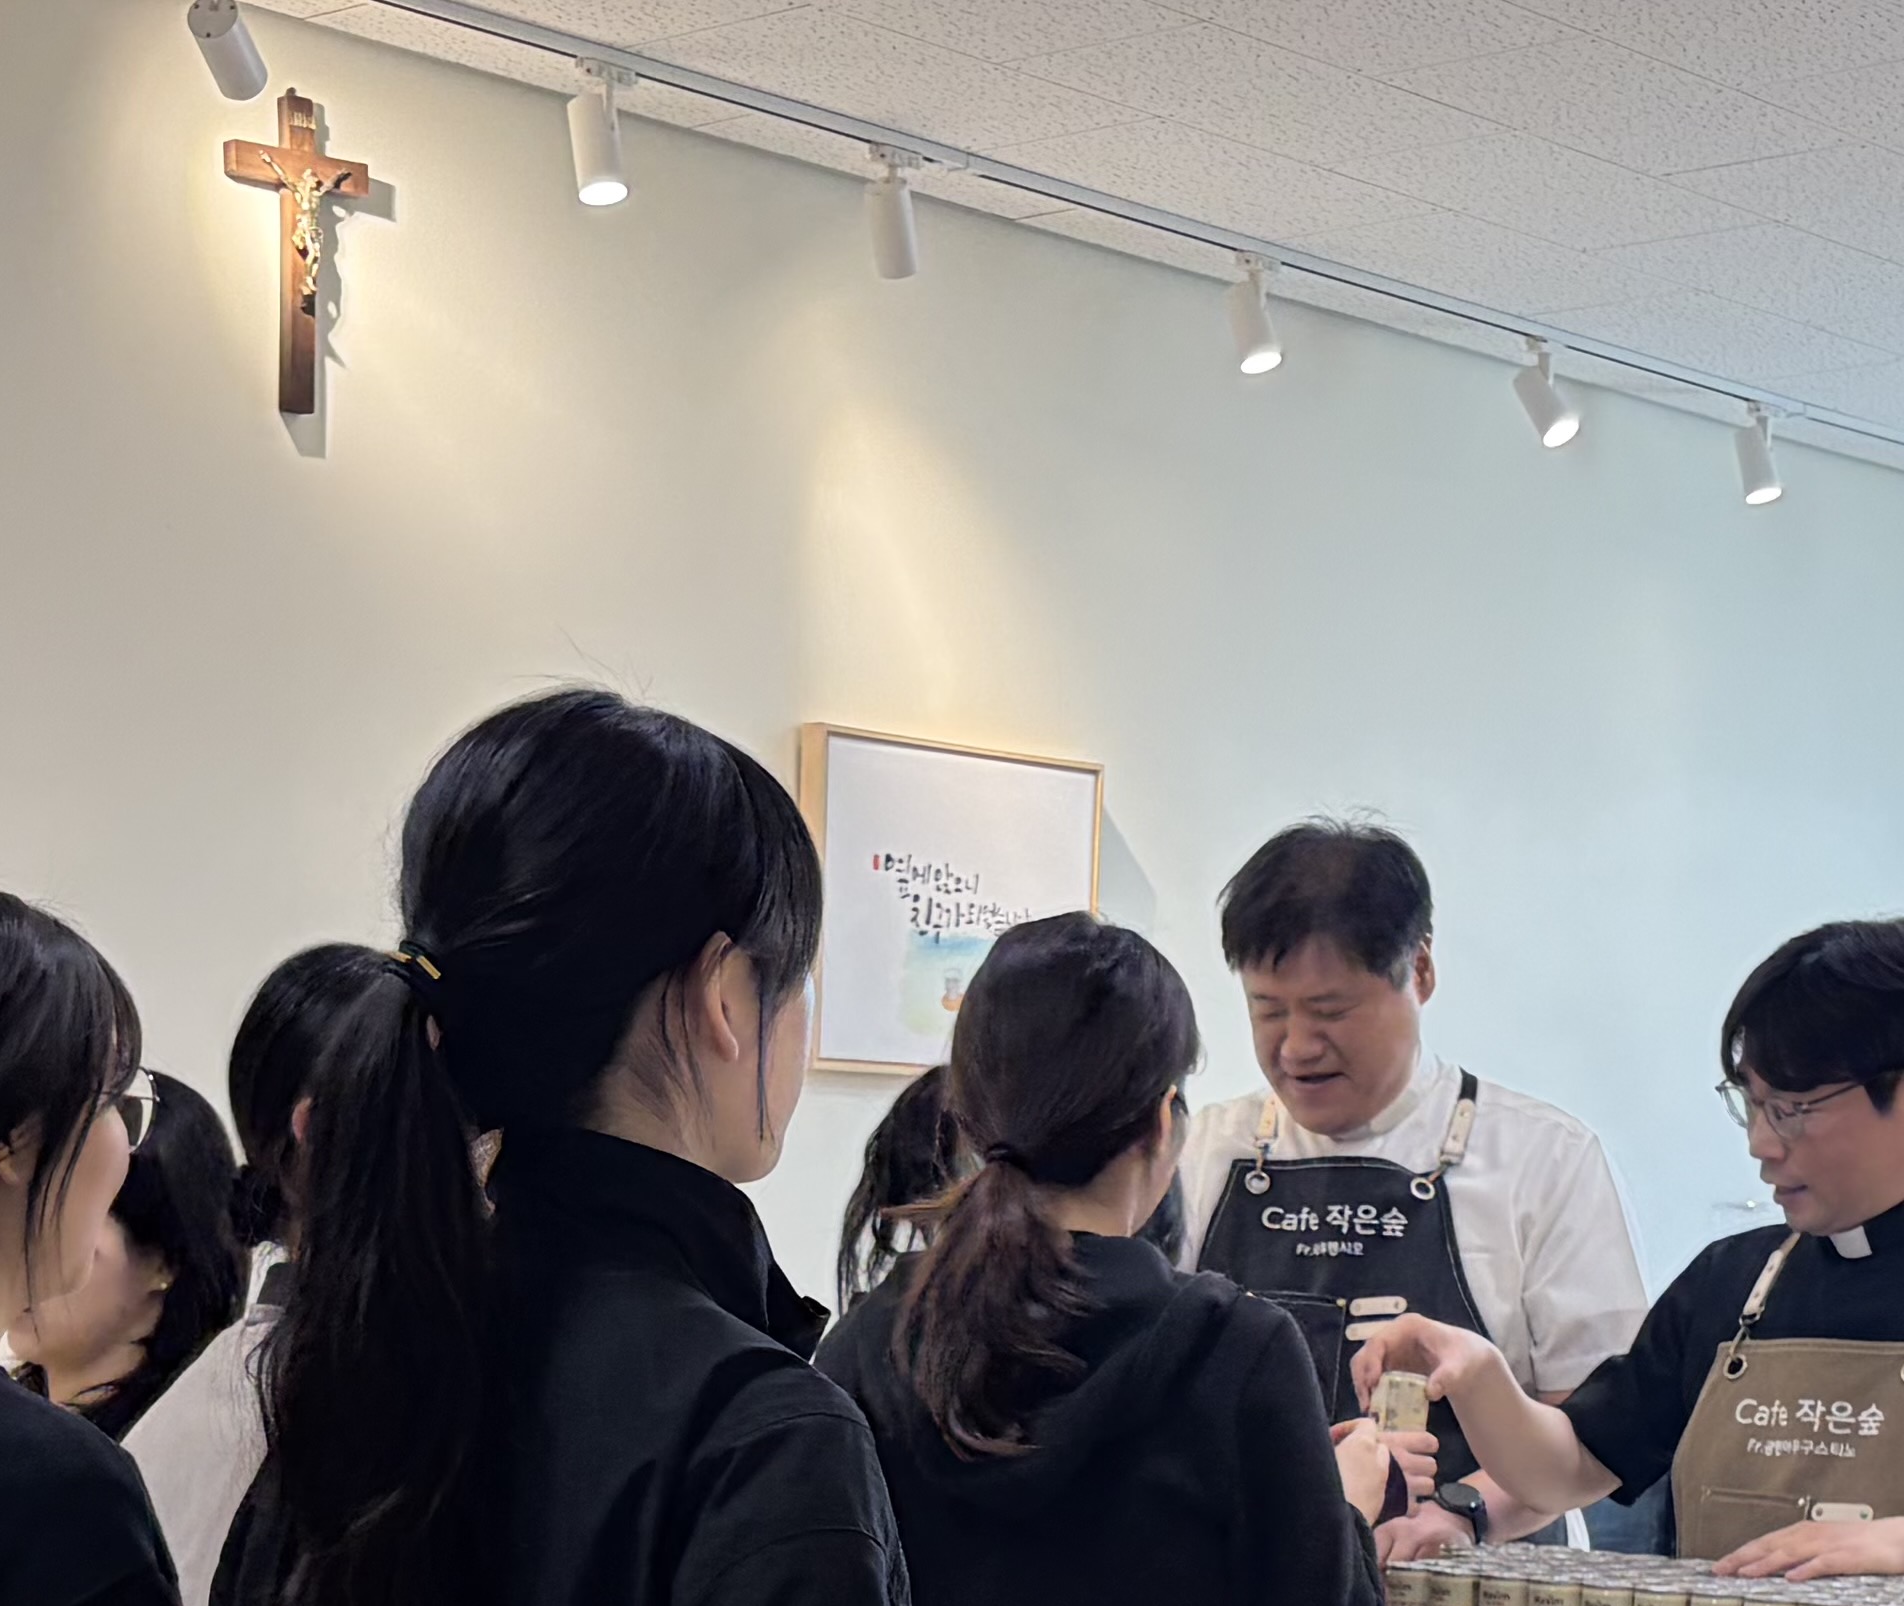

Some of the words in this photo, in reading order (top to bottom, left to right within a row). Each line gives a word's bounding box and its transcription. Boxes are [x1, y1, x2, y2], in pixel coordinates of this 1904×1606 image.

[1261, 1206, 1320, 1232] Cafe
[1326, 1204, 1409, 1237] 작은숲
[1735, 1398, 1788, 1427] Cafe
[1796, 1399, 1885, 1436] 작은숲
